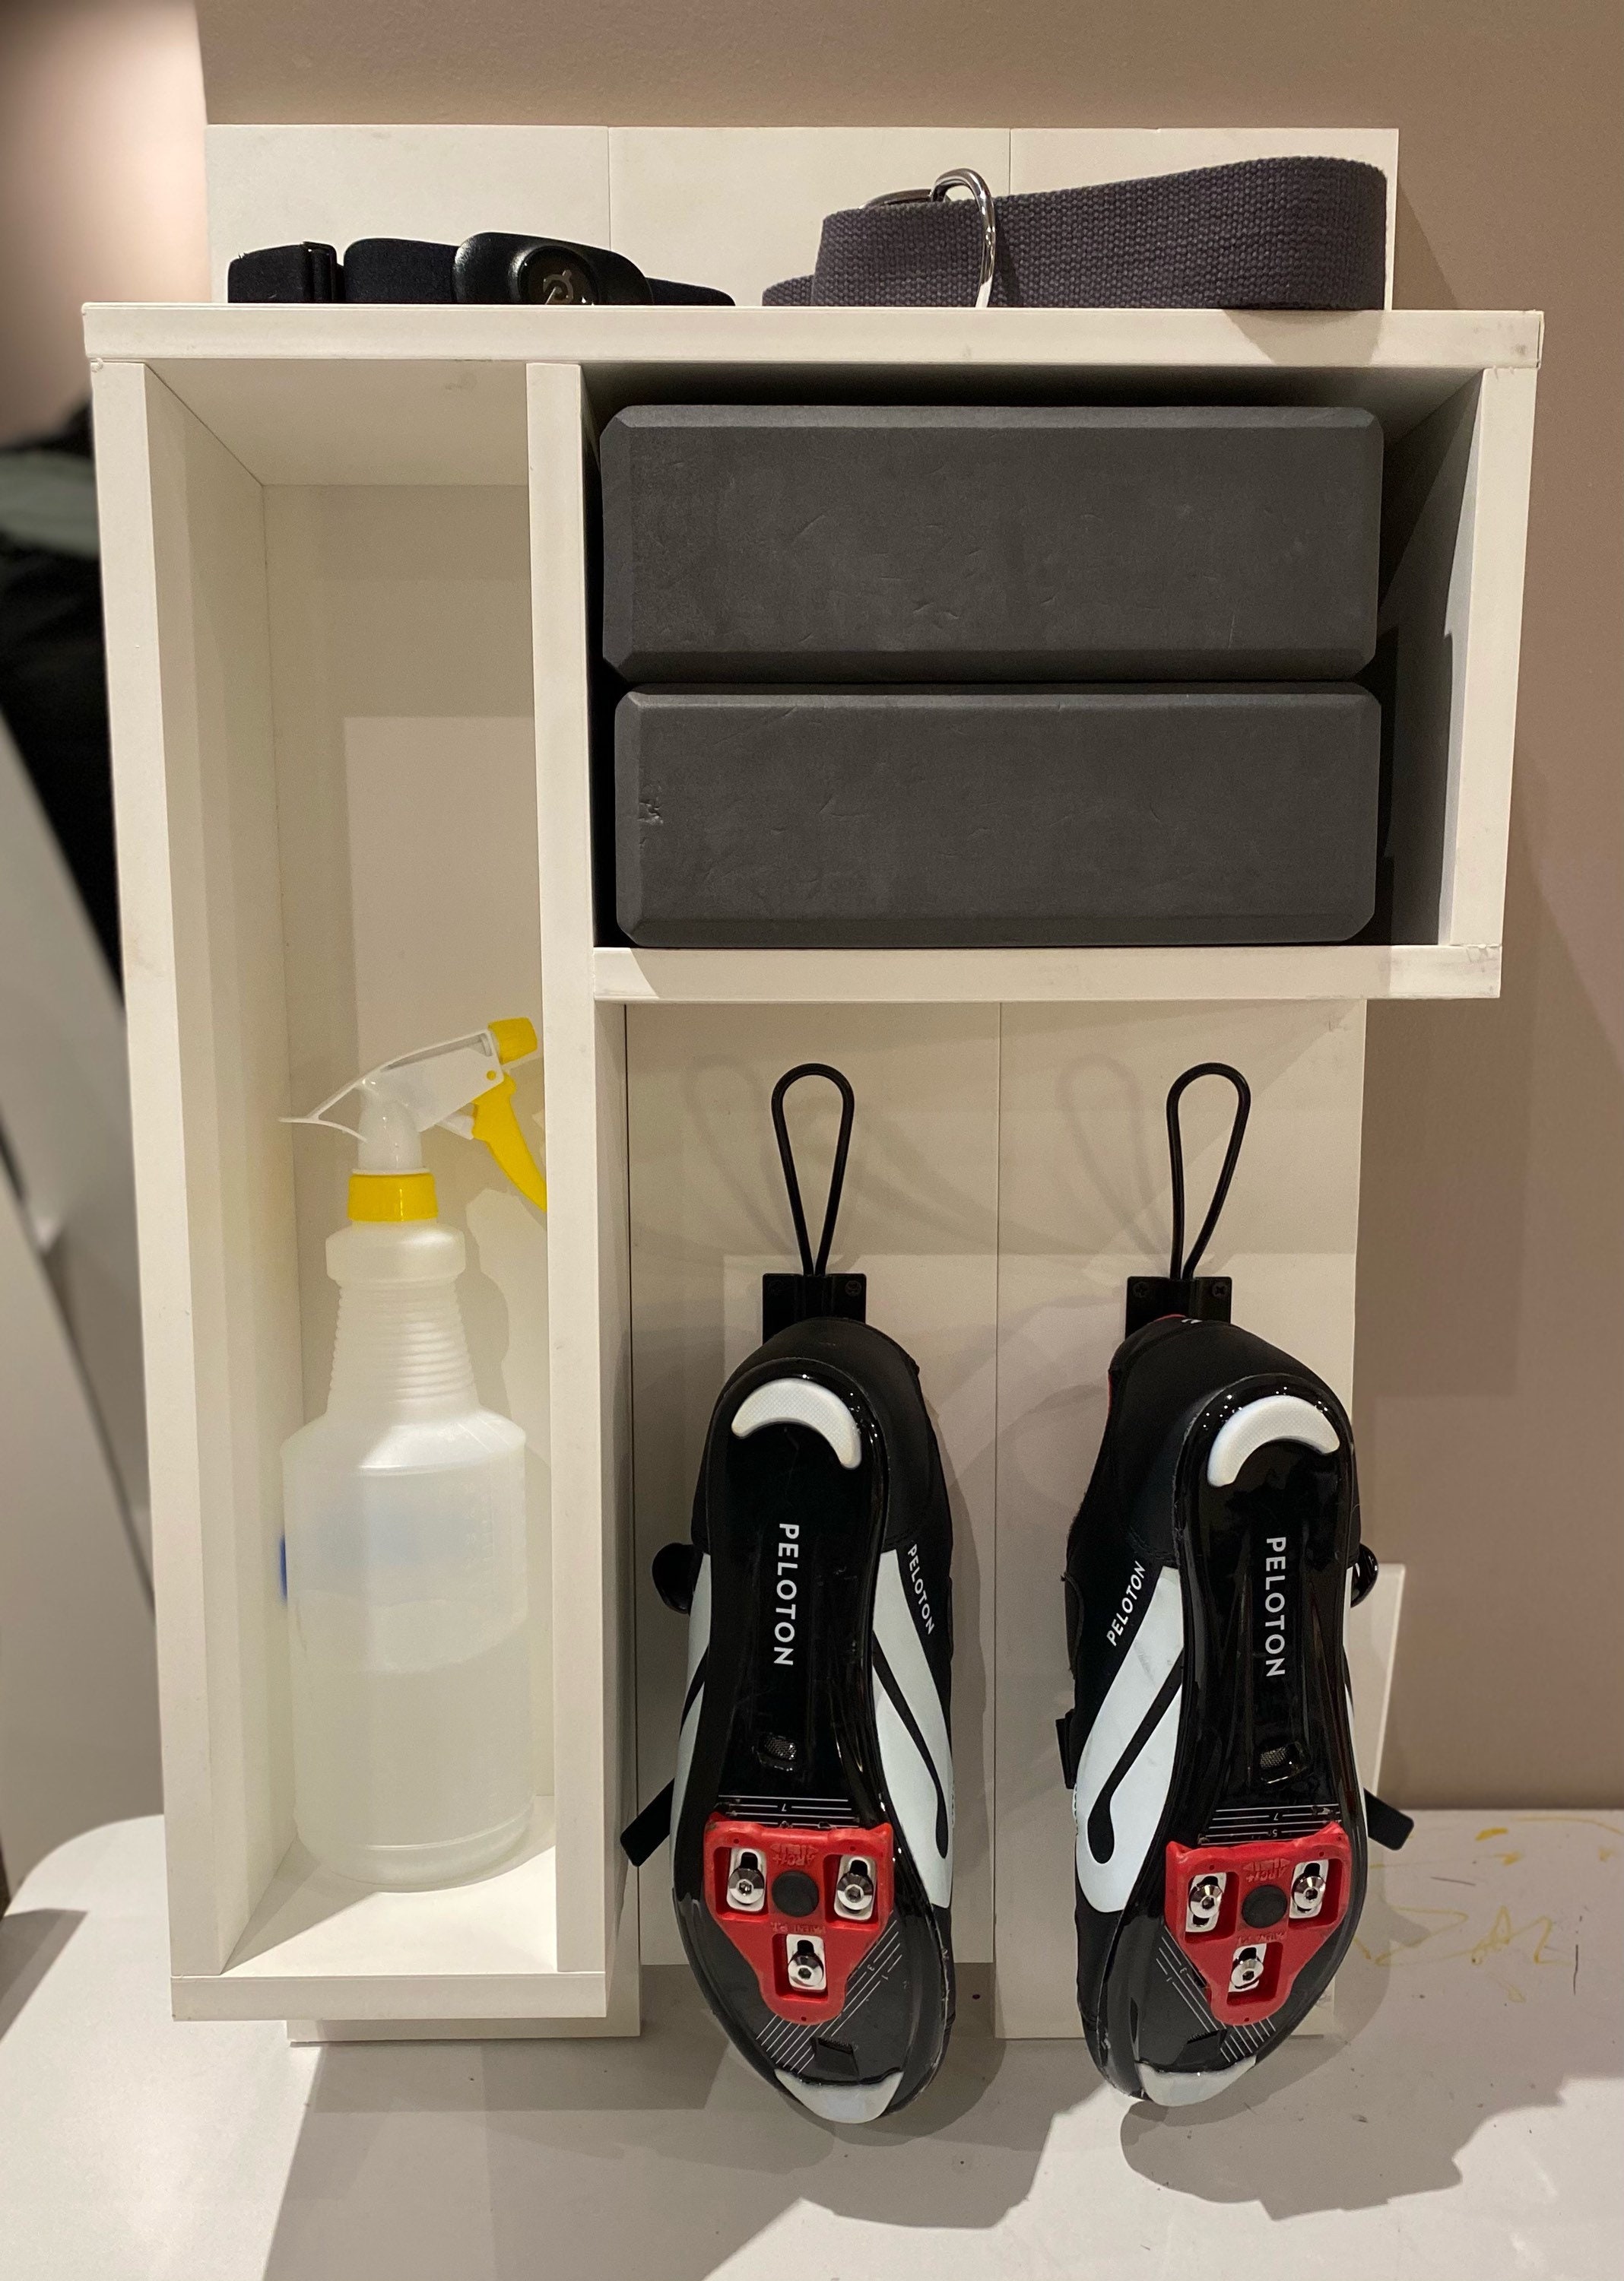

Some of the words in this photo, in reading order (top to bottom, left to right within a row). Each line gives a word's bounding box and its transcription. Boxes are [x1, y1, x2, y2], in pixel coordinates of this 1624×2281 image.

[773, 1523, 800, 1666] PELOTON
[907, 1543, 935, 1635] PELOTON
[1105, 1560, 1147, 1647] PELOTON
[1264, 1536, 1286, 1677] PELOTON
[1273, 1813, 1279, 1821] 7
